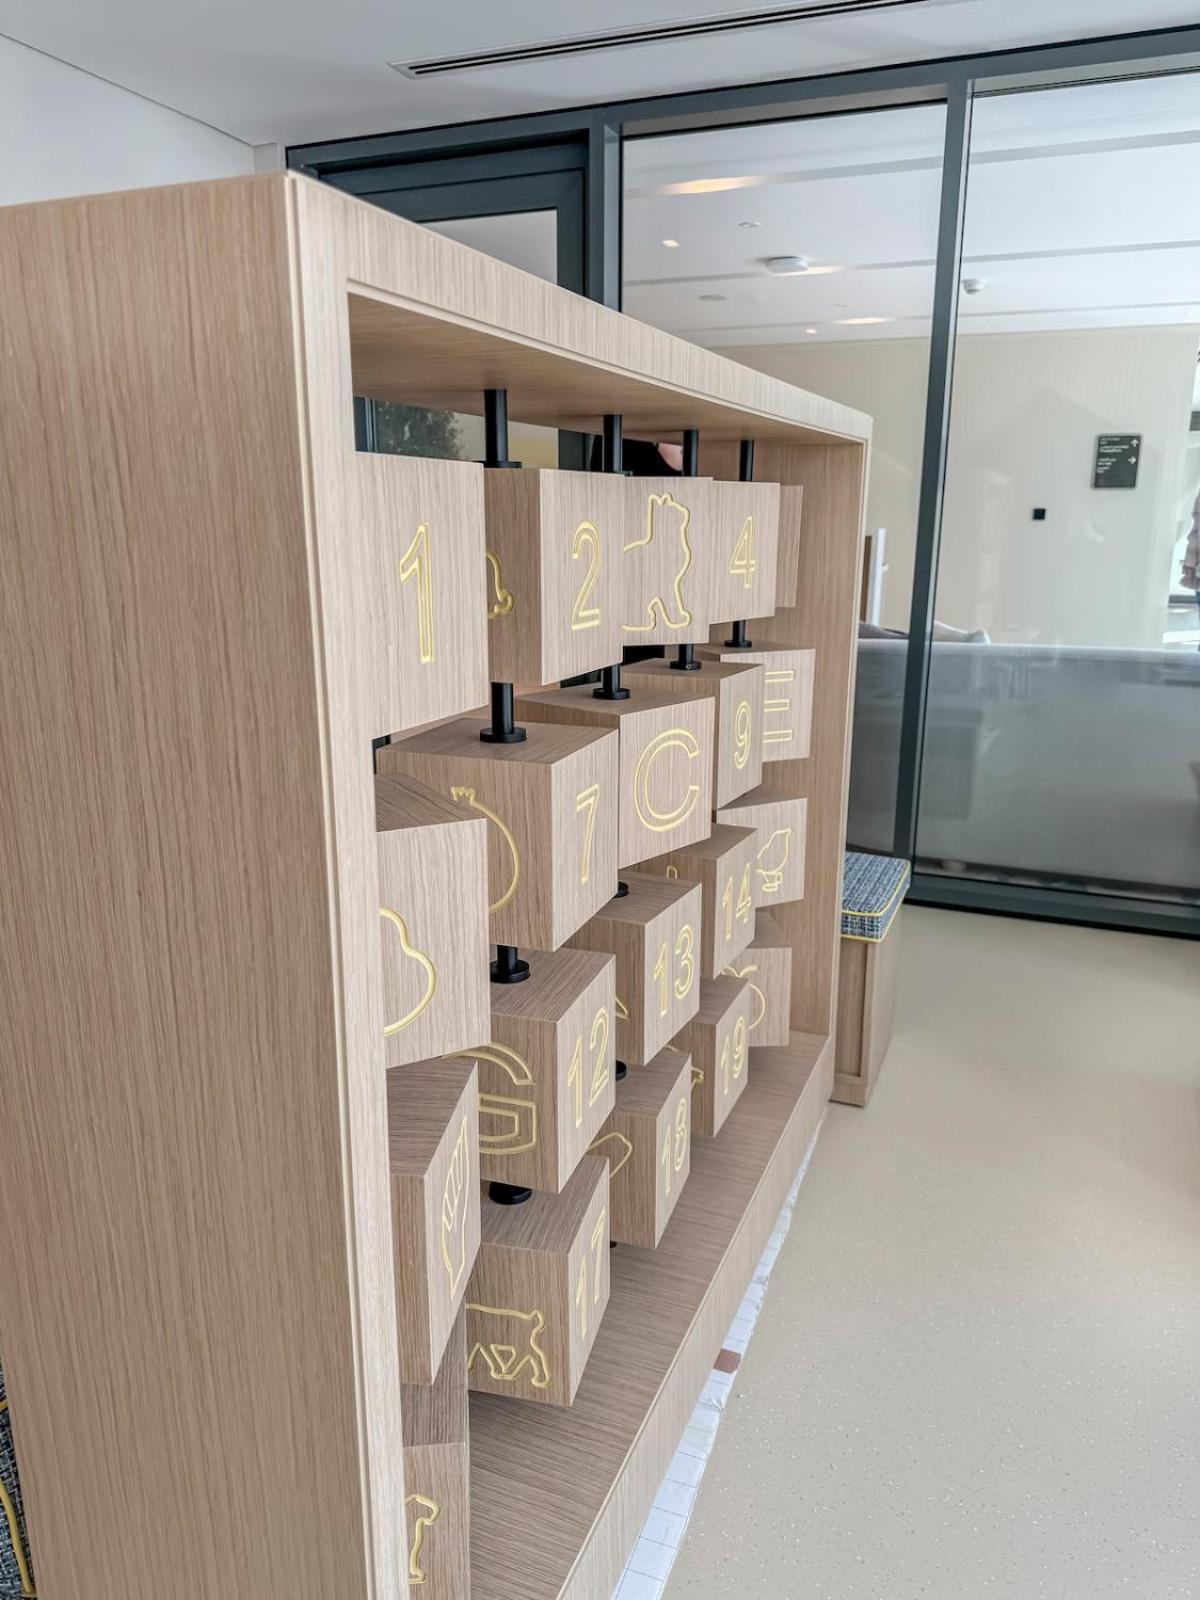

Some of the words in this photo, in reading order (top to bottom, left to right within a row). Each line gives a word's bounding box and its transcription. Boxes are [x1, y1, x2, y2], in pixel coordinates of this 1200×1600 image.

[399, 521, 435, 665] 1
[571, 520, 602, 632] 2
[729, 515, 757, 589] 4
[633, 728, 700, 832] C
[734, 700, 751, 770] 9
[576, 783, 600, 885] 7
[722, 862, 753, 941] 14
[654, 924, 695, 1017] 13
[567, 1007, 609, 1129] 12
[720, 1015, 747, 1095] 19
[661, 1096, 688, 1196] 18
[575, 1206, 606, 1339] 17
